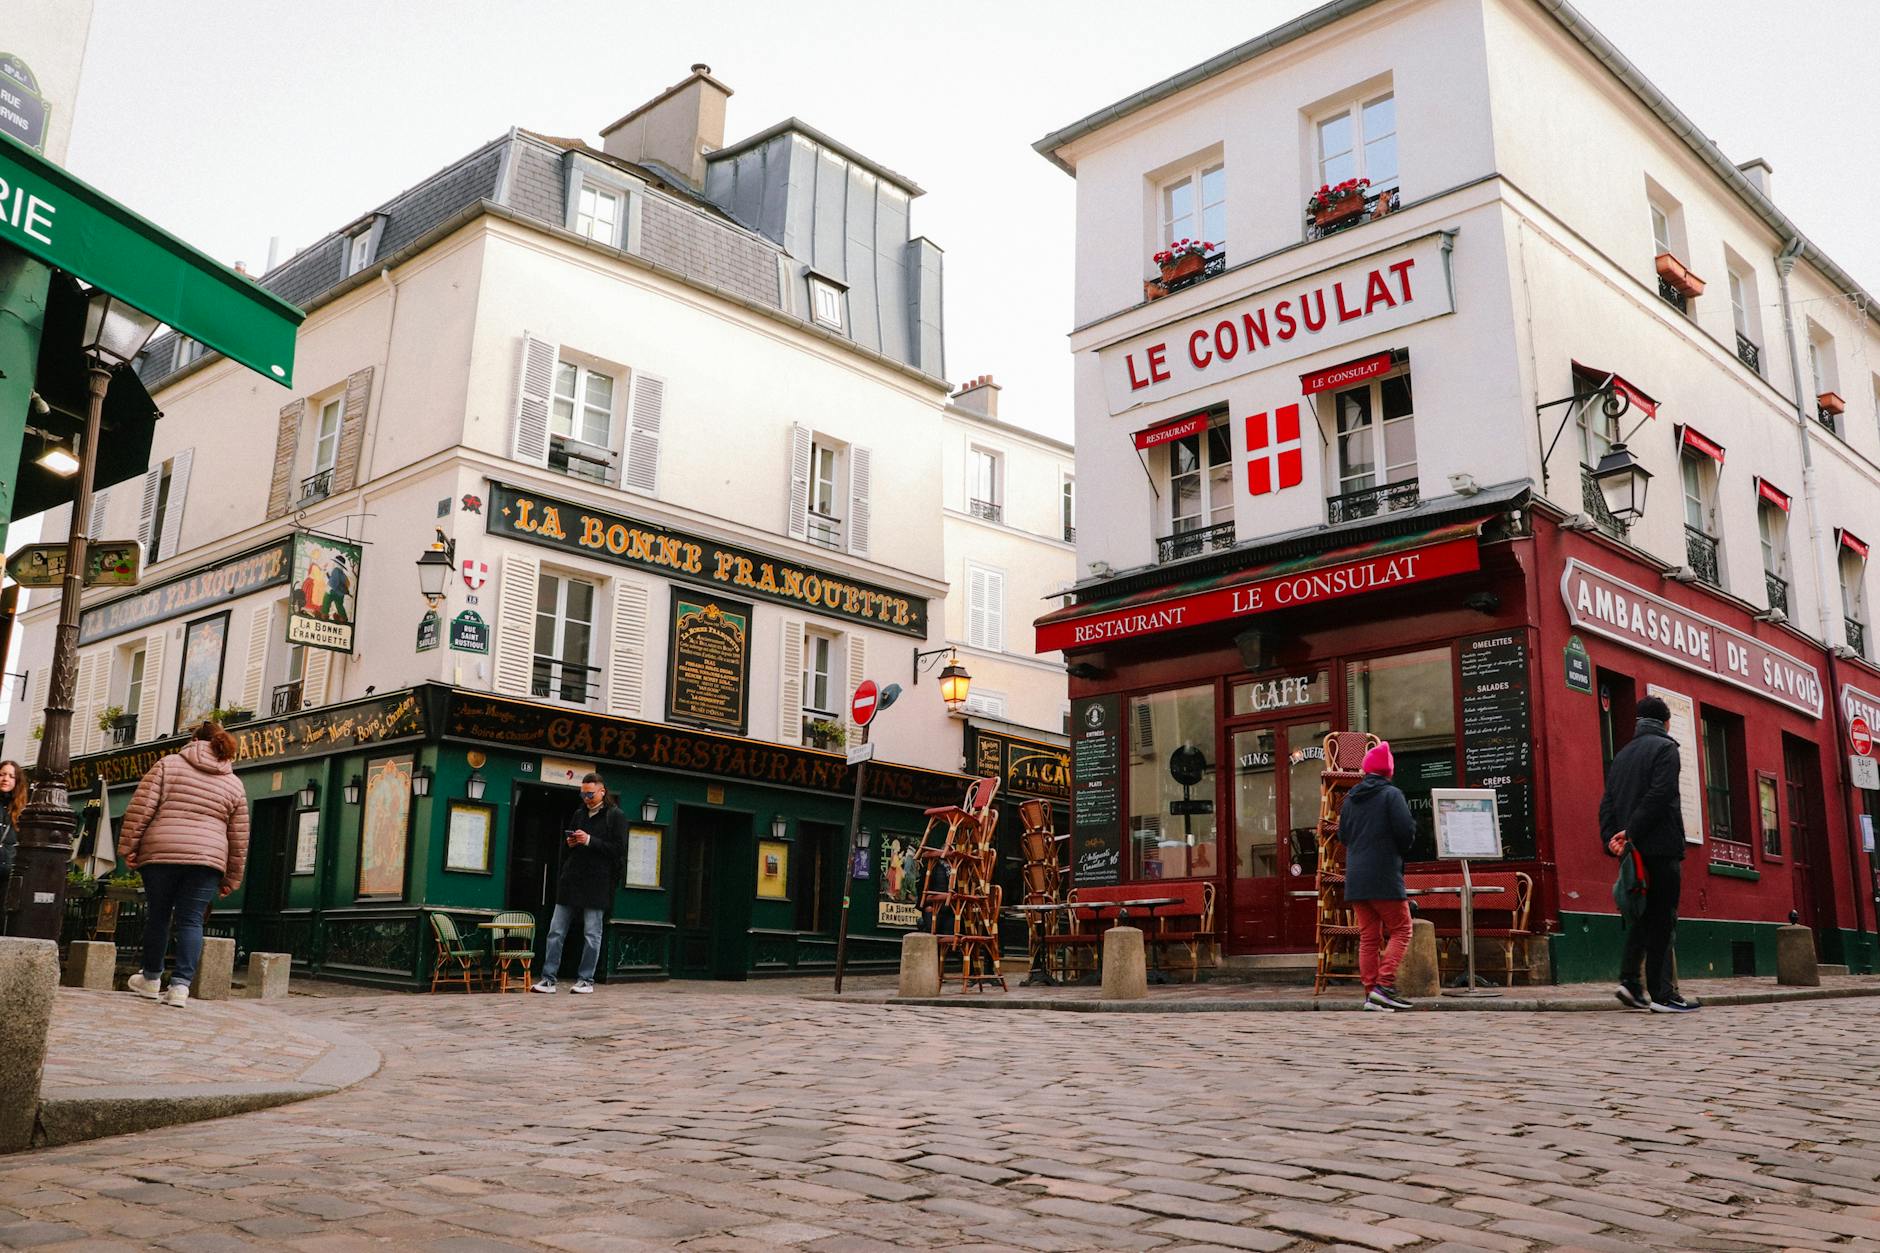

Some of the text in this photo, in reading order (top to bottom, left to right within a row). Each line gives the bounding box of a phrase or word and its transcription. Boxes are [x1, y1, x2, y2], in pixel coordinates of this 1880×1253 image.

[1, 89, 22, 109] RUE
[1126, 258, 1415, 391] LE CONSULAT
[1312, 361, 1380, 389] LE CONSULAT
[1145, 421, 1197, 444] RESTAURANT
[515, 498, 910, 626] LA BONNE FRANQUETTE
[109, 591, 162, 626] BONNE
[164, 547, 284, 611] FRANQUETTE
[1074, 554, 1421, 643] RESTAURANT LE CONSULAT
[300, 619, 343, 636] LA BONNE
[423, 624, 434, 634] RUE
[463, 625, 477, 633] RUE
[293, 628, 348, 646] FRANQUETTE
[454, 639, 484, 649] RUSTIQUE
[461, 632, 479, 641] SAINT
[1472, 637, 1513, 649] OMELETTES
[1577, 579, 1819, 706] AMBASSADE DE SAVOIE
[1573, 659, 1583, 670] RUE
[1477, 682, 1509, 693] SALADES
[548, 717, 636, 758] CAFÉ
[650, 733, 848, 789] RESTAURANT
[1239, 753, 1269, 767] VINS
[521, 762, 533, 772] 18
[1026, 762, 1038, 778] LA
[1483, 776, 1511, 787] CRÊPES
[885, 904, 894, 912] LA
